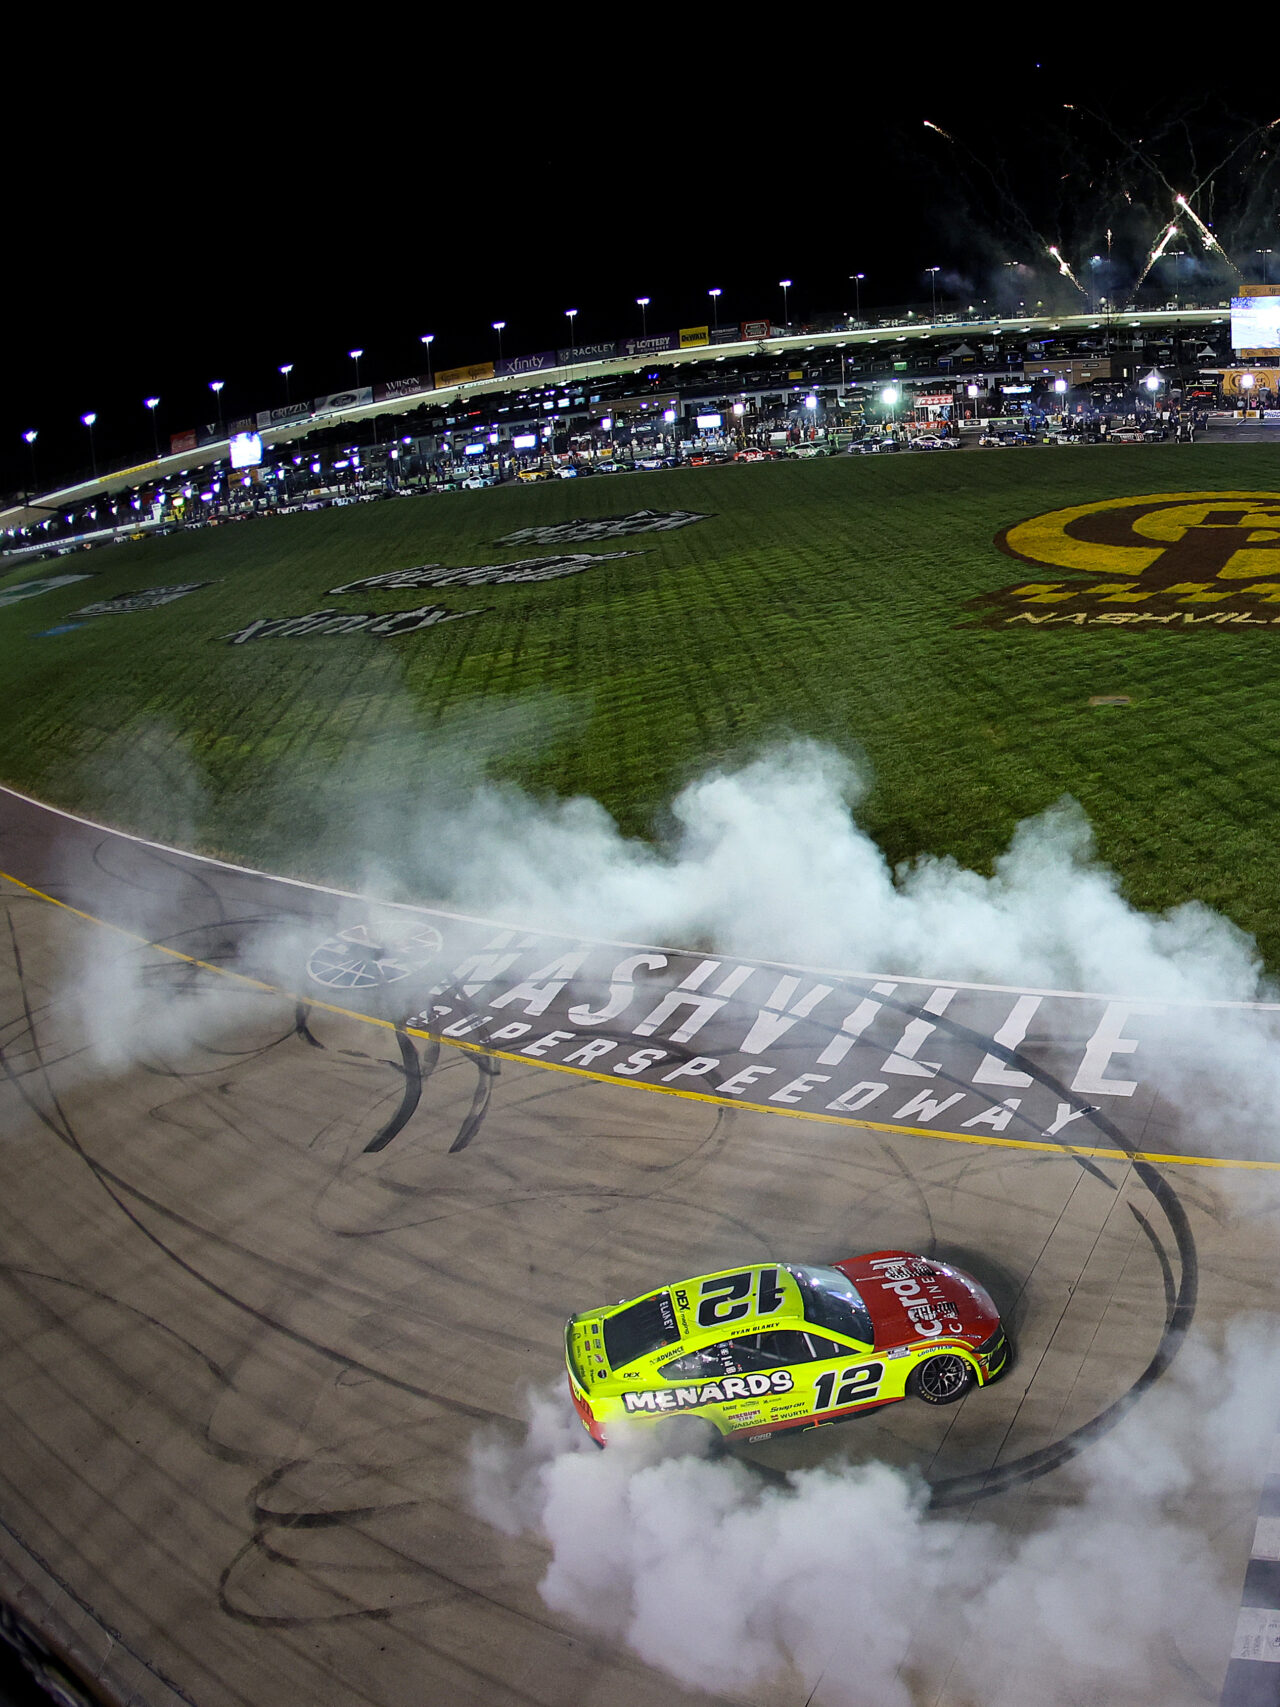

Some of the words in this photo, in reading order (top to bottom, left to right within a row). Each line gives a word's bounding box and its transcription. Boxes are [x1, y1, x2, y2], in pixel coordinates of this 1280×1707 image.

[572, 343, 615, 357] RACKLEY
[506, 356, 544, 373] xfinity
[428, 931, 1148, 1098] NASHVILLE
[405, 1004, 1102, 1138] SUPERSPEEDWAY
[675, 1289, 691, 1310] DEX
[697, 1267, 785, 1328] 12
[730, 1327, 751, 1336] RYAN
[752, 1322, 780, 1332] BLANEY
[656, 1345, 685, 1362] ADVANCE
[623, 1371, 794, 1412] MENARDS
[813, 1361, 885, 1412] 12
[728, 1409, 761, 1420] DISCOUNT
